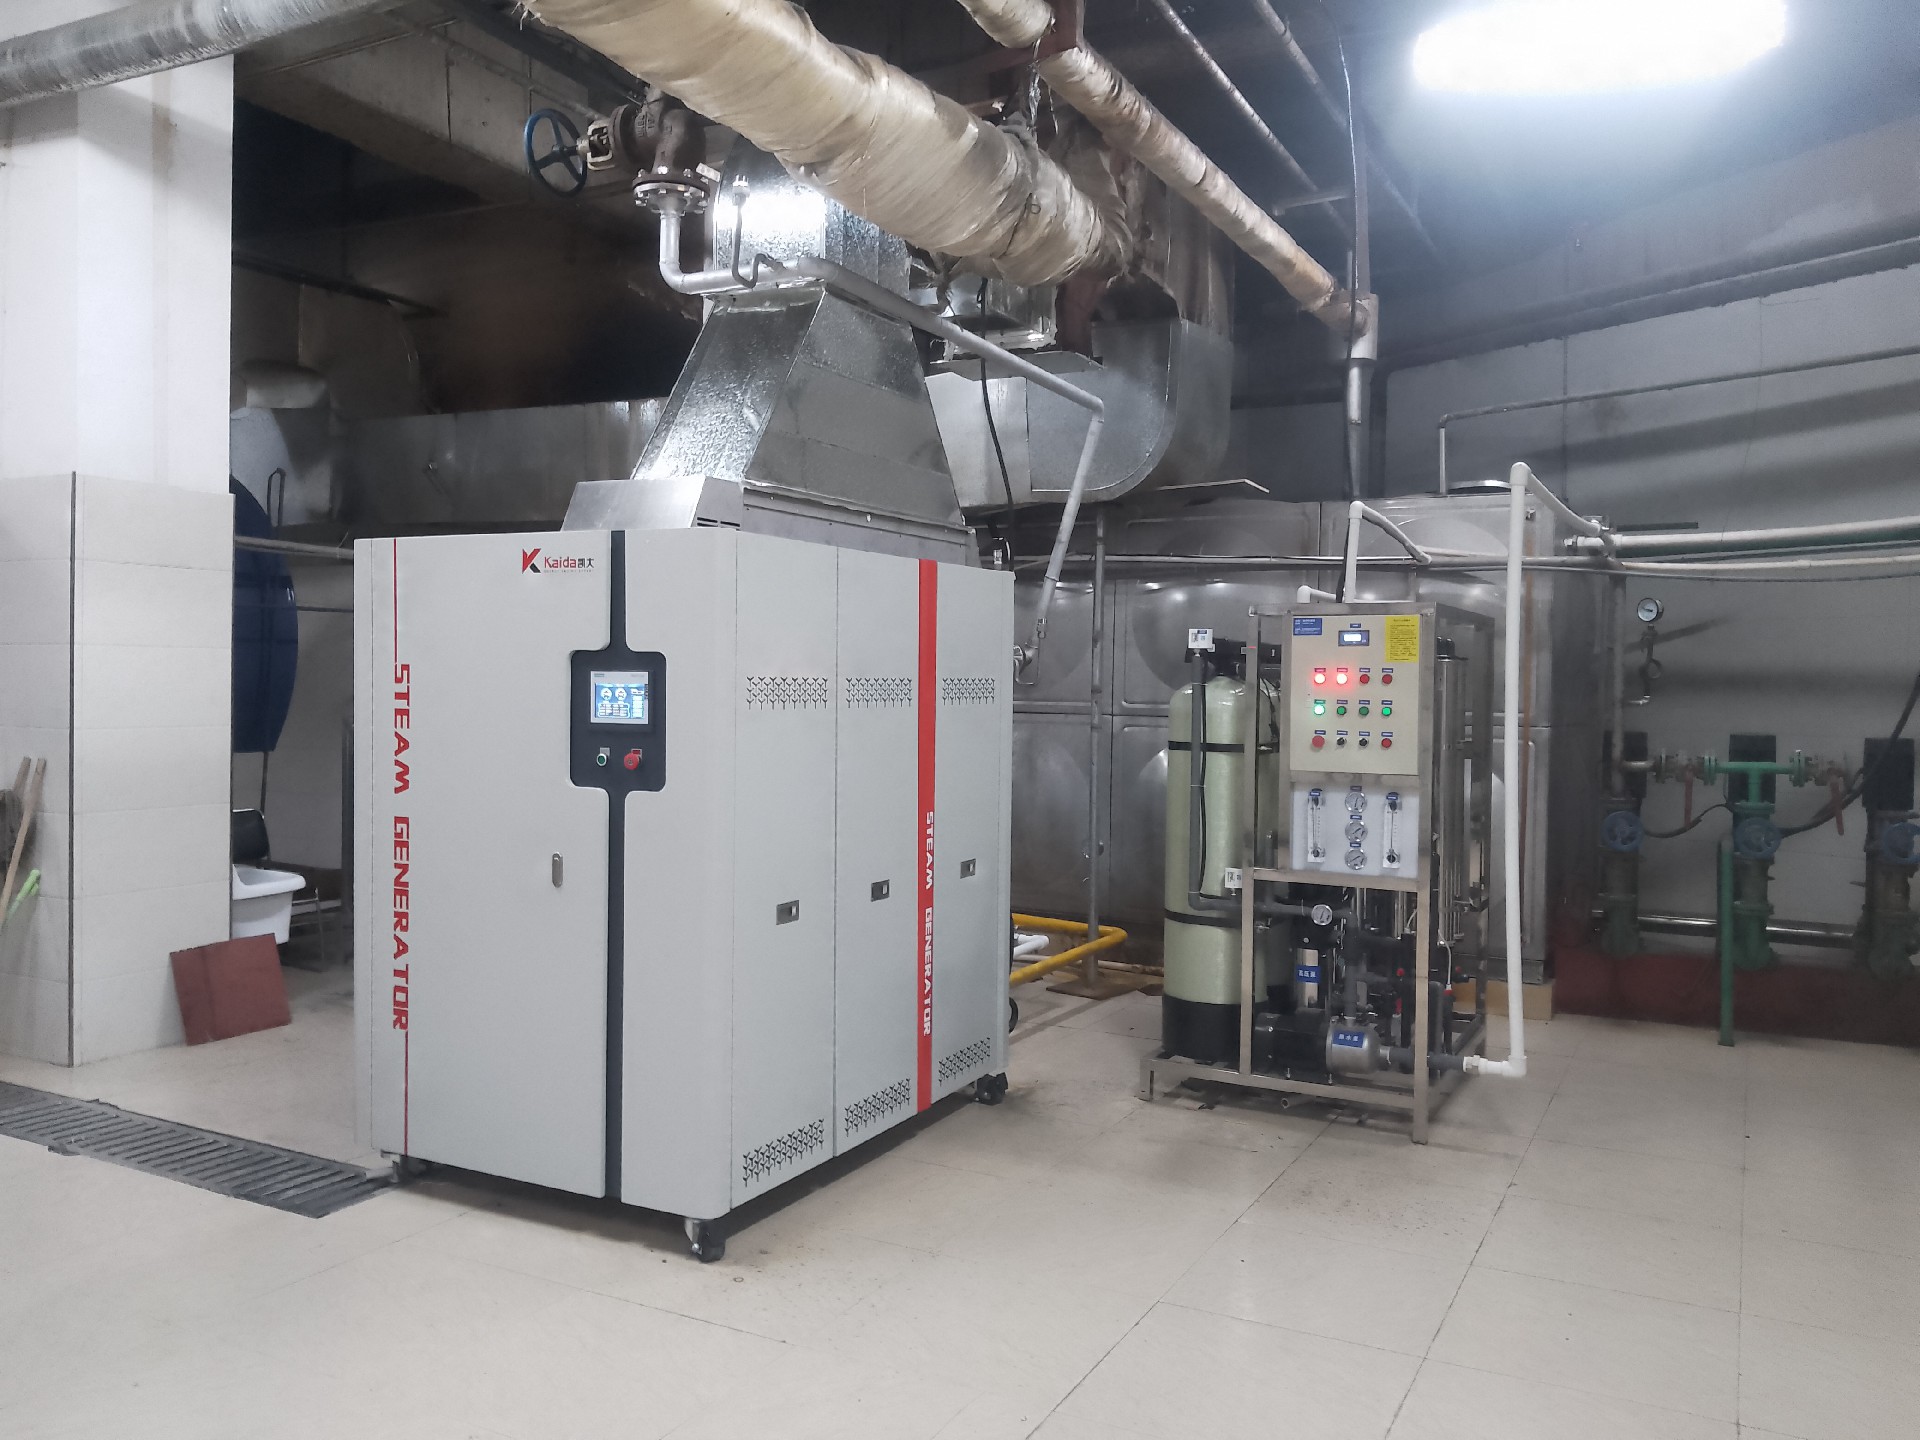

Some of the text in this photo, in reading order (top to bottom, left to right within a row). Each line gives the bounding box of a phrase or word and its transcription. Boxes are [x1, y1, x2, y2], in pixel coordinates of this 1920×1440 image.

[544, 556, 577, 569] Kaida
[392, 663, 411, 1031] STEAM GENERATOR
[923, 811, 934, 1037] STEAM GENERATOR
